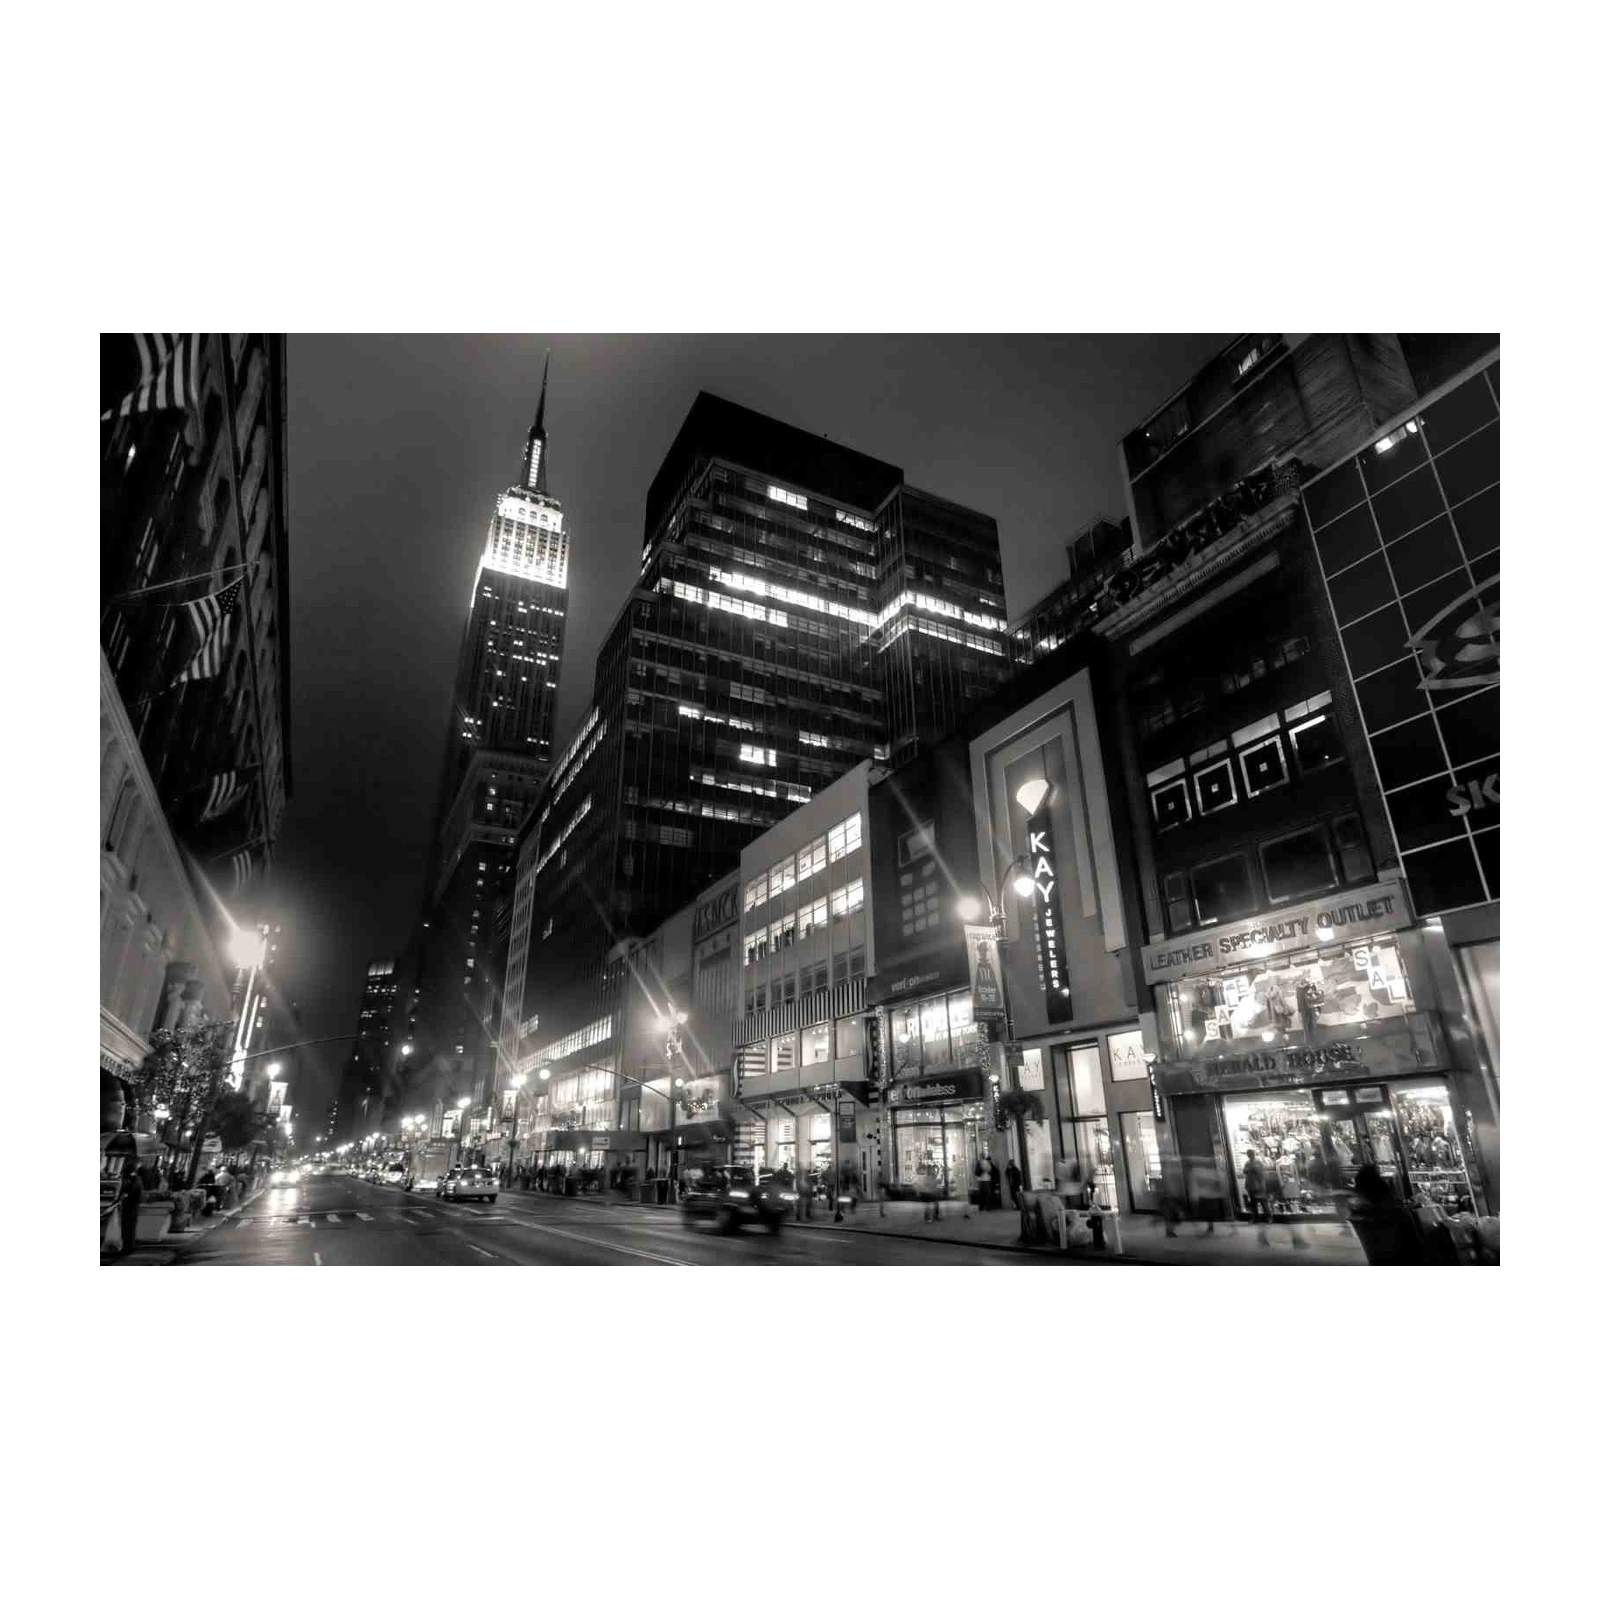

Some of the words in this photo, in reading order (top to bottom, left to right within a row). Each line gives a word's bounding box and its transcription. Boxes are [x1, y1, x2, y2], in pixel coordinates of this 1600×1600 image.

[1030, 831, 1054, 902] KAY
[1045, 908, 1060, 989] JEWELERS
[1150, 943, 1213, 970] LEATHER
[1219, 916, 1309, 953] SPECIALTY
[1317, 895, 1393, 928] OUTLET
